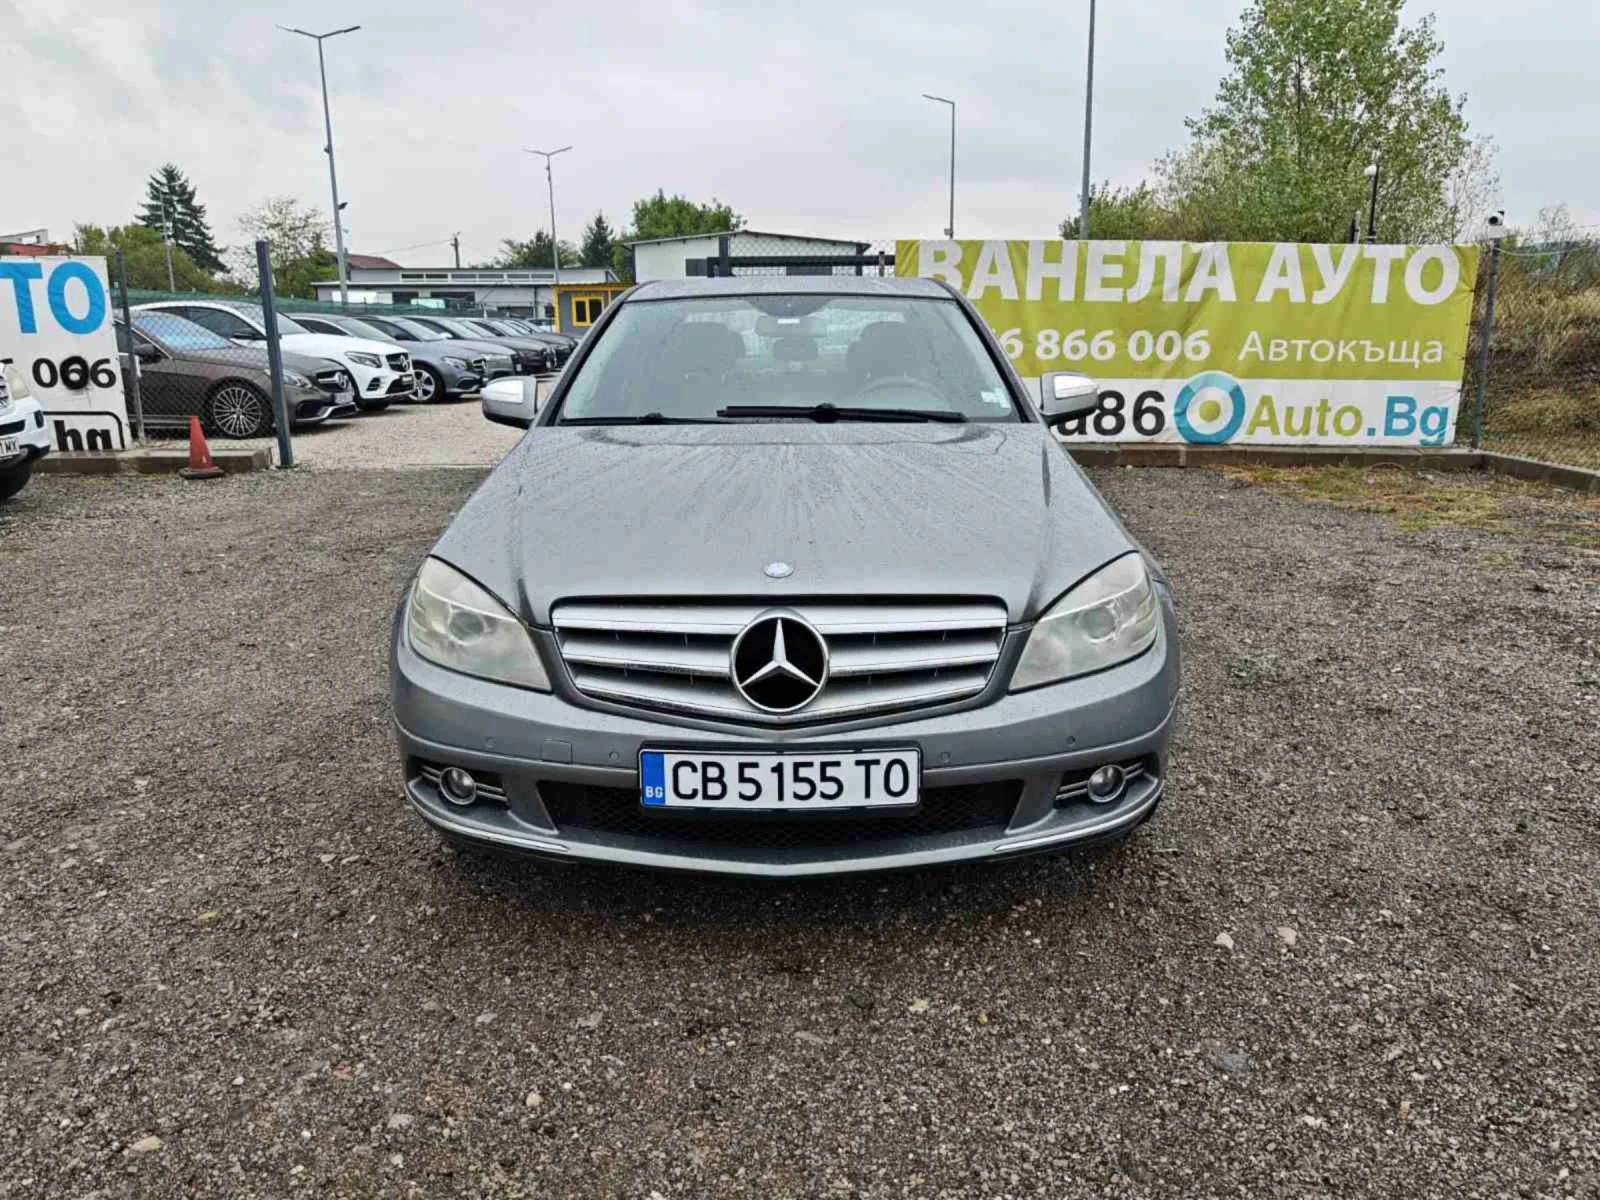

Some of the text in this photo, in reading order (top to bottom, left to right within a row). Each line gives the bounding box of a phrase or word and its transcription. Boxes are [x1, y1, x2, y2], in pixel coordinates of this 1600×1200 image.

[918, 240, 1461, 305] ВАНЕЛА АУТО
[1035, 328, 1116, 361] 866
[1127, 330, 1212, 362] 006
[1238, 330, 1443, 369] Автокъща
[1245, 394, 1450, 446] Auto.Bg
[645, 785, 664, 799] BG
